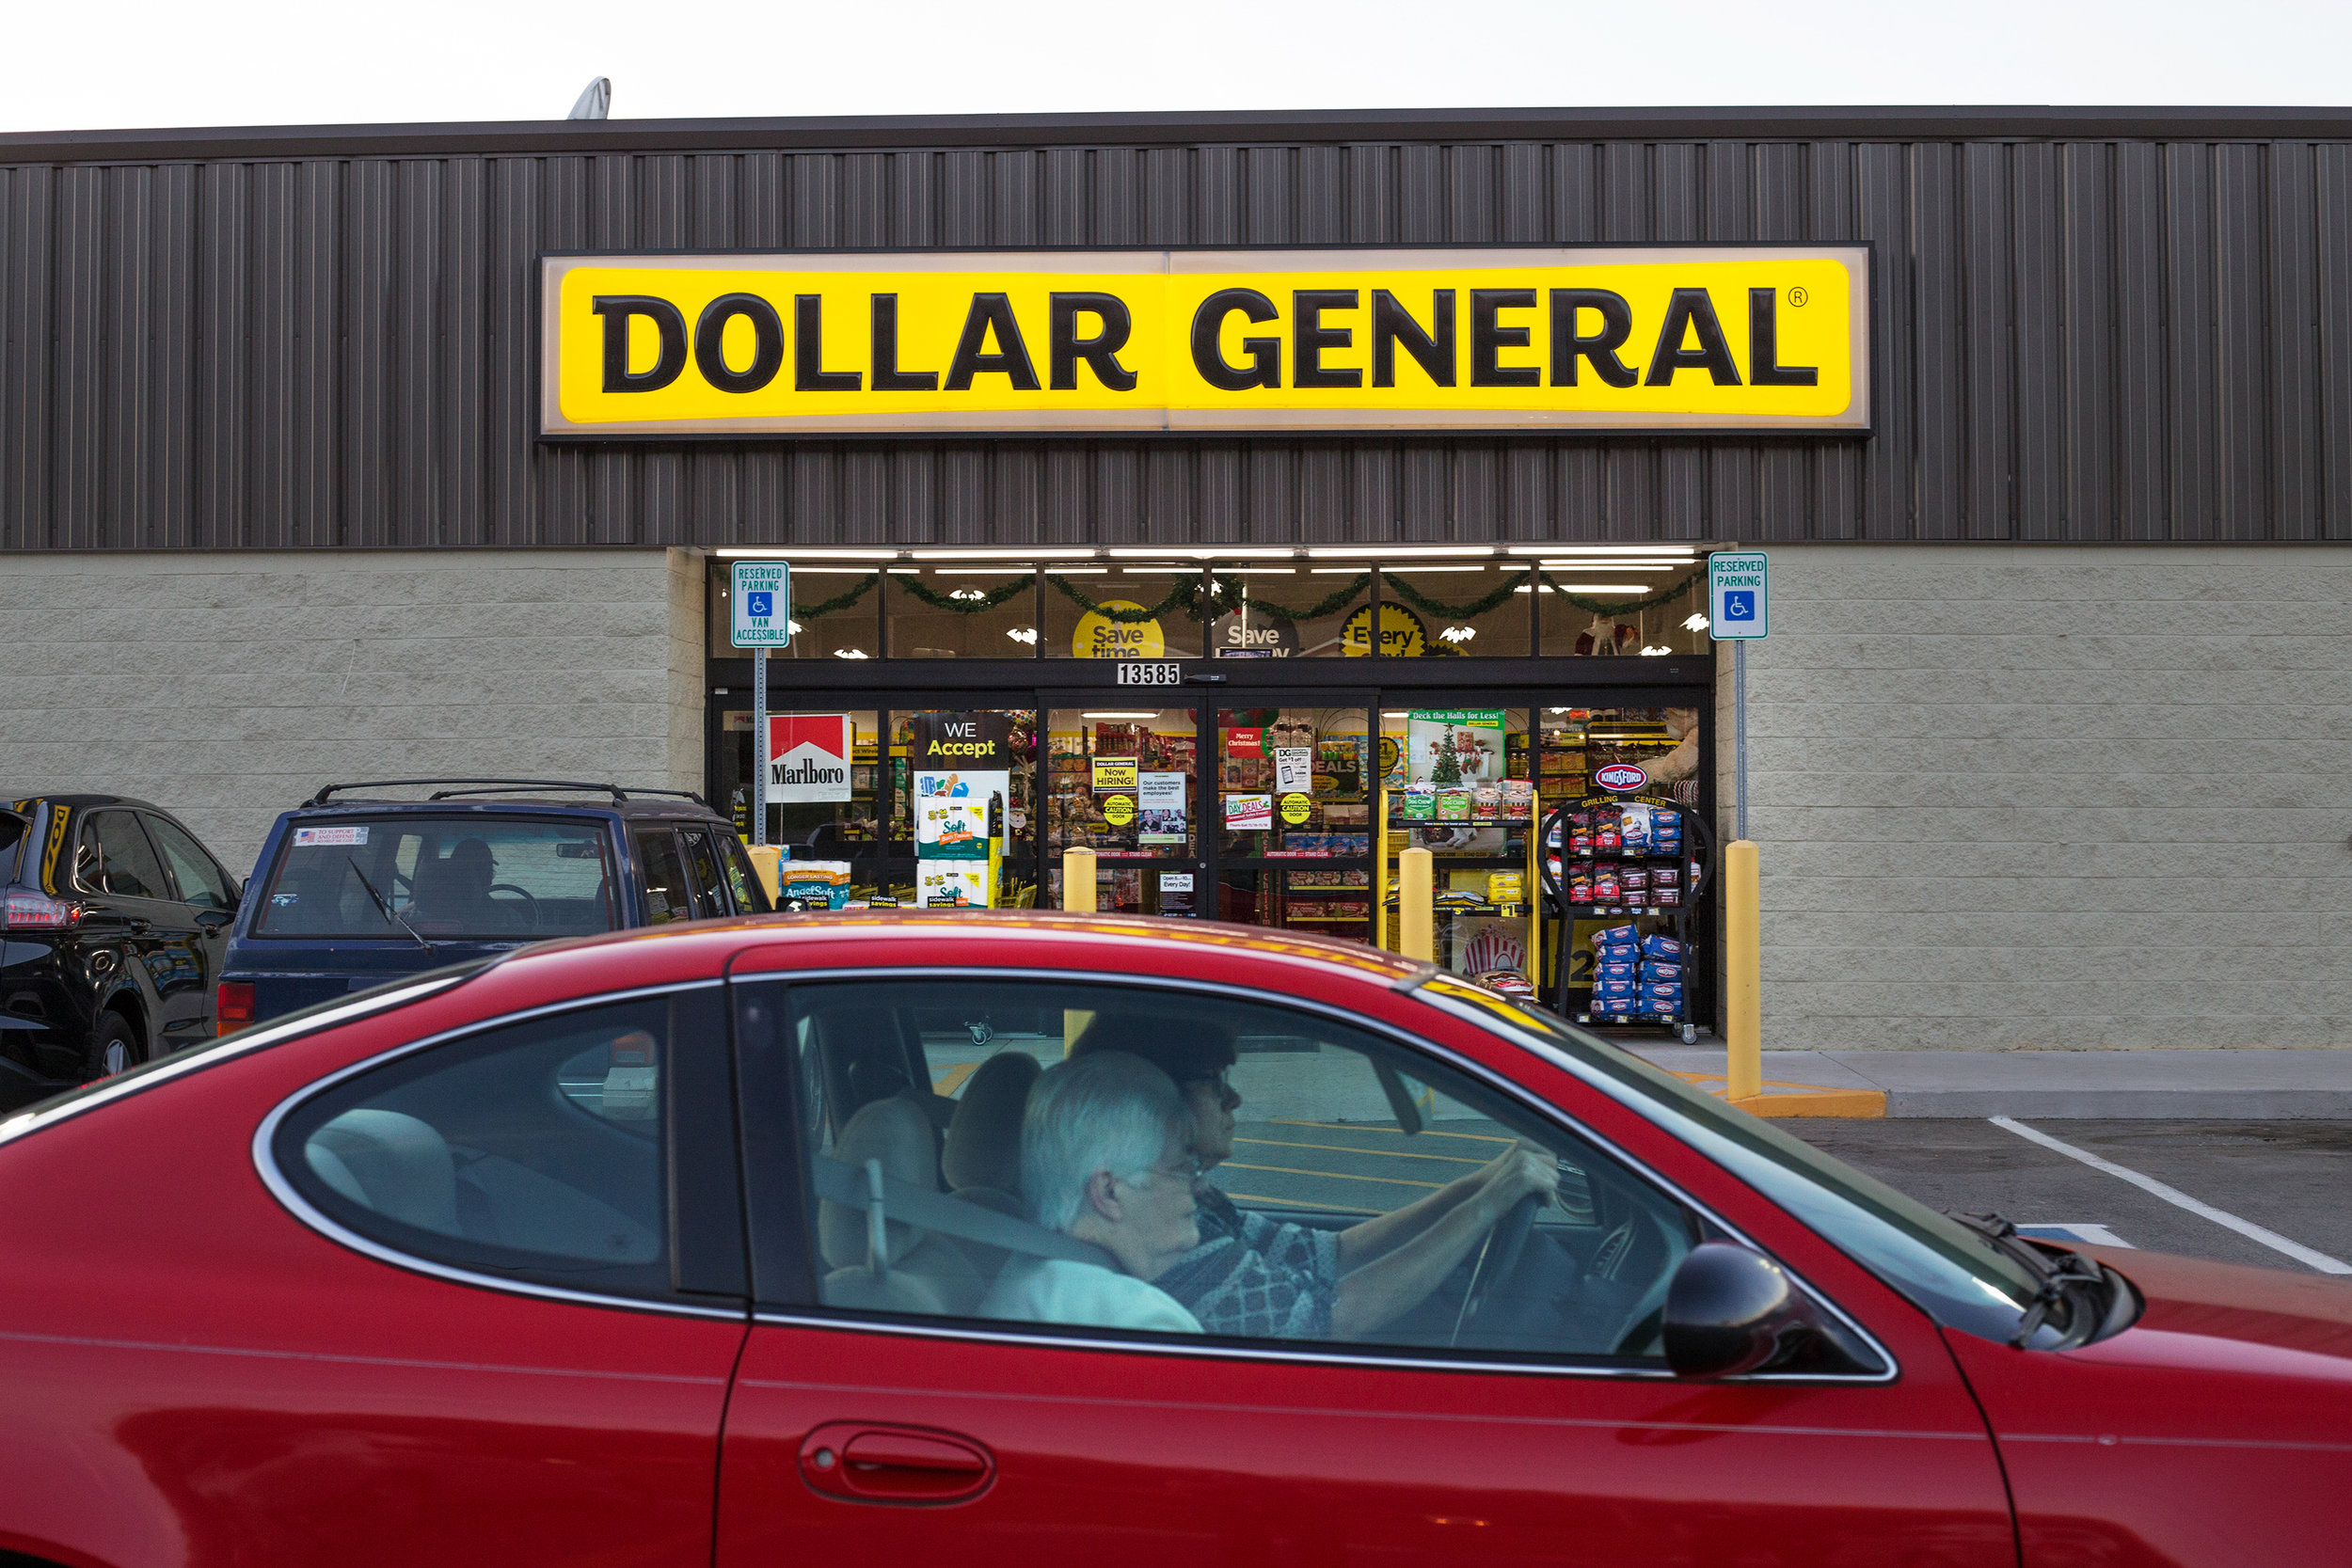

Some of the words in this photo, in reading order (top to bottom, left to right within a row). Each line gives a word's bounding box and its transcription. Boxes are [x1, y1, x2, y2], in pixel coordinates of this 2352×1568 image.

[592, 292, 1138, 393] DOLLAR
[1190, 287, 1819, 390] GENERAL
[739, 568, 782, 579] RESERVED
[1713, 561, 1764, 572] RESERVED
[741, 580, 779, 591] PARKING
[1717, 576, 1761, 586] PARKING
[752, 617, 769, 627] VAN
[736, 629, 784, 640] ACCESSIBLE
[1092, 626, 1144, 643] Save
[1228, 626, 1279, 644] Save
[1120, 664, 1178, 684] 13585
[945, 722, 977, 737] WE
[927, 739, 995, 758] Accept
[771, 758, 844, 784] Marlboro
[1600, 768, 1642, 786] KINGSFORD
[1229, 804, 1242, 815] DAY
[1242, 800, 1263, 813] DEALS
[1581, 795, 1618, 808] GRILLING
[1634, 796, 1667, 807] CENTER
[943, 819, 967, 834] Soft
[1502, 905, 1513, 916] $1
